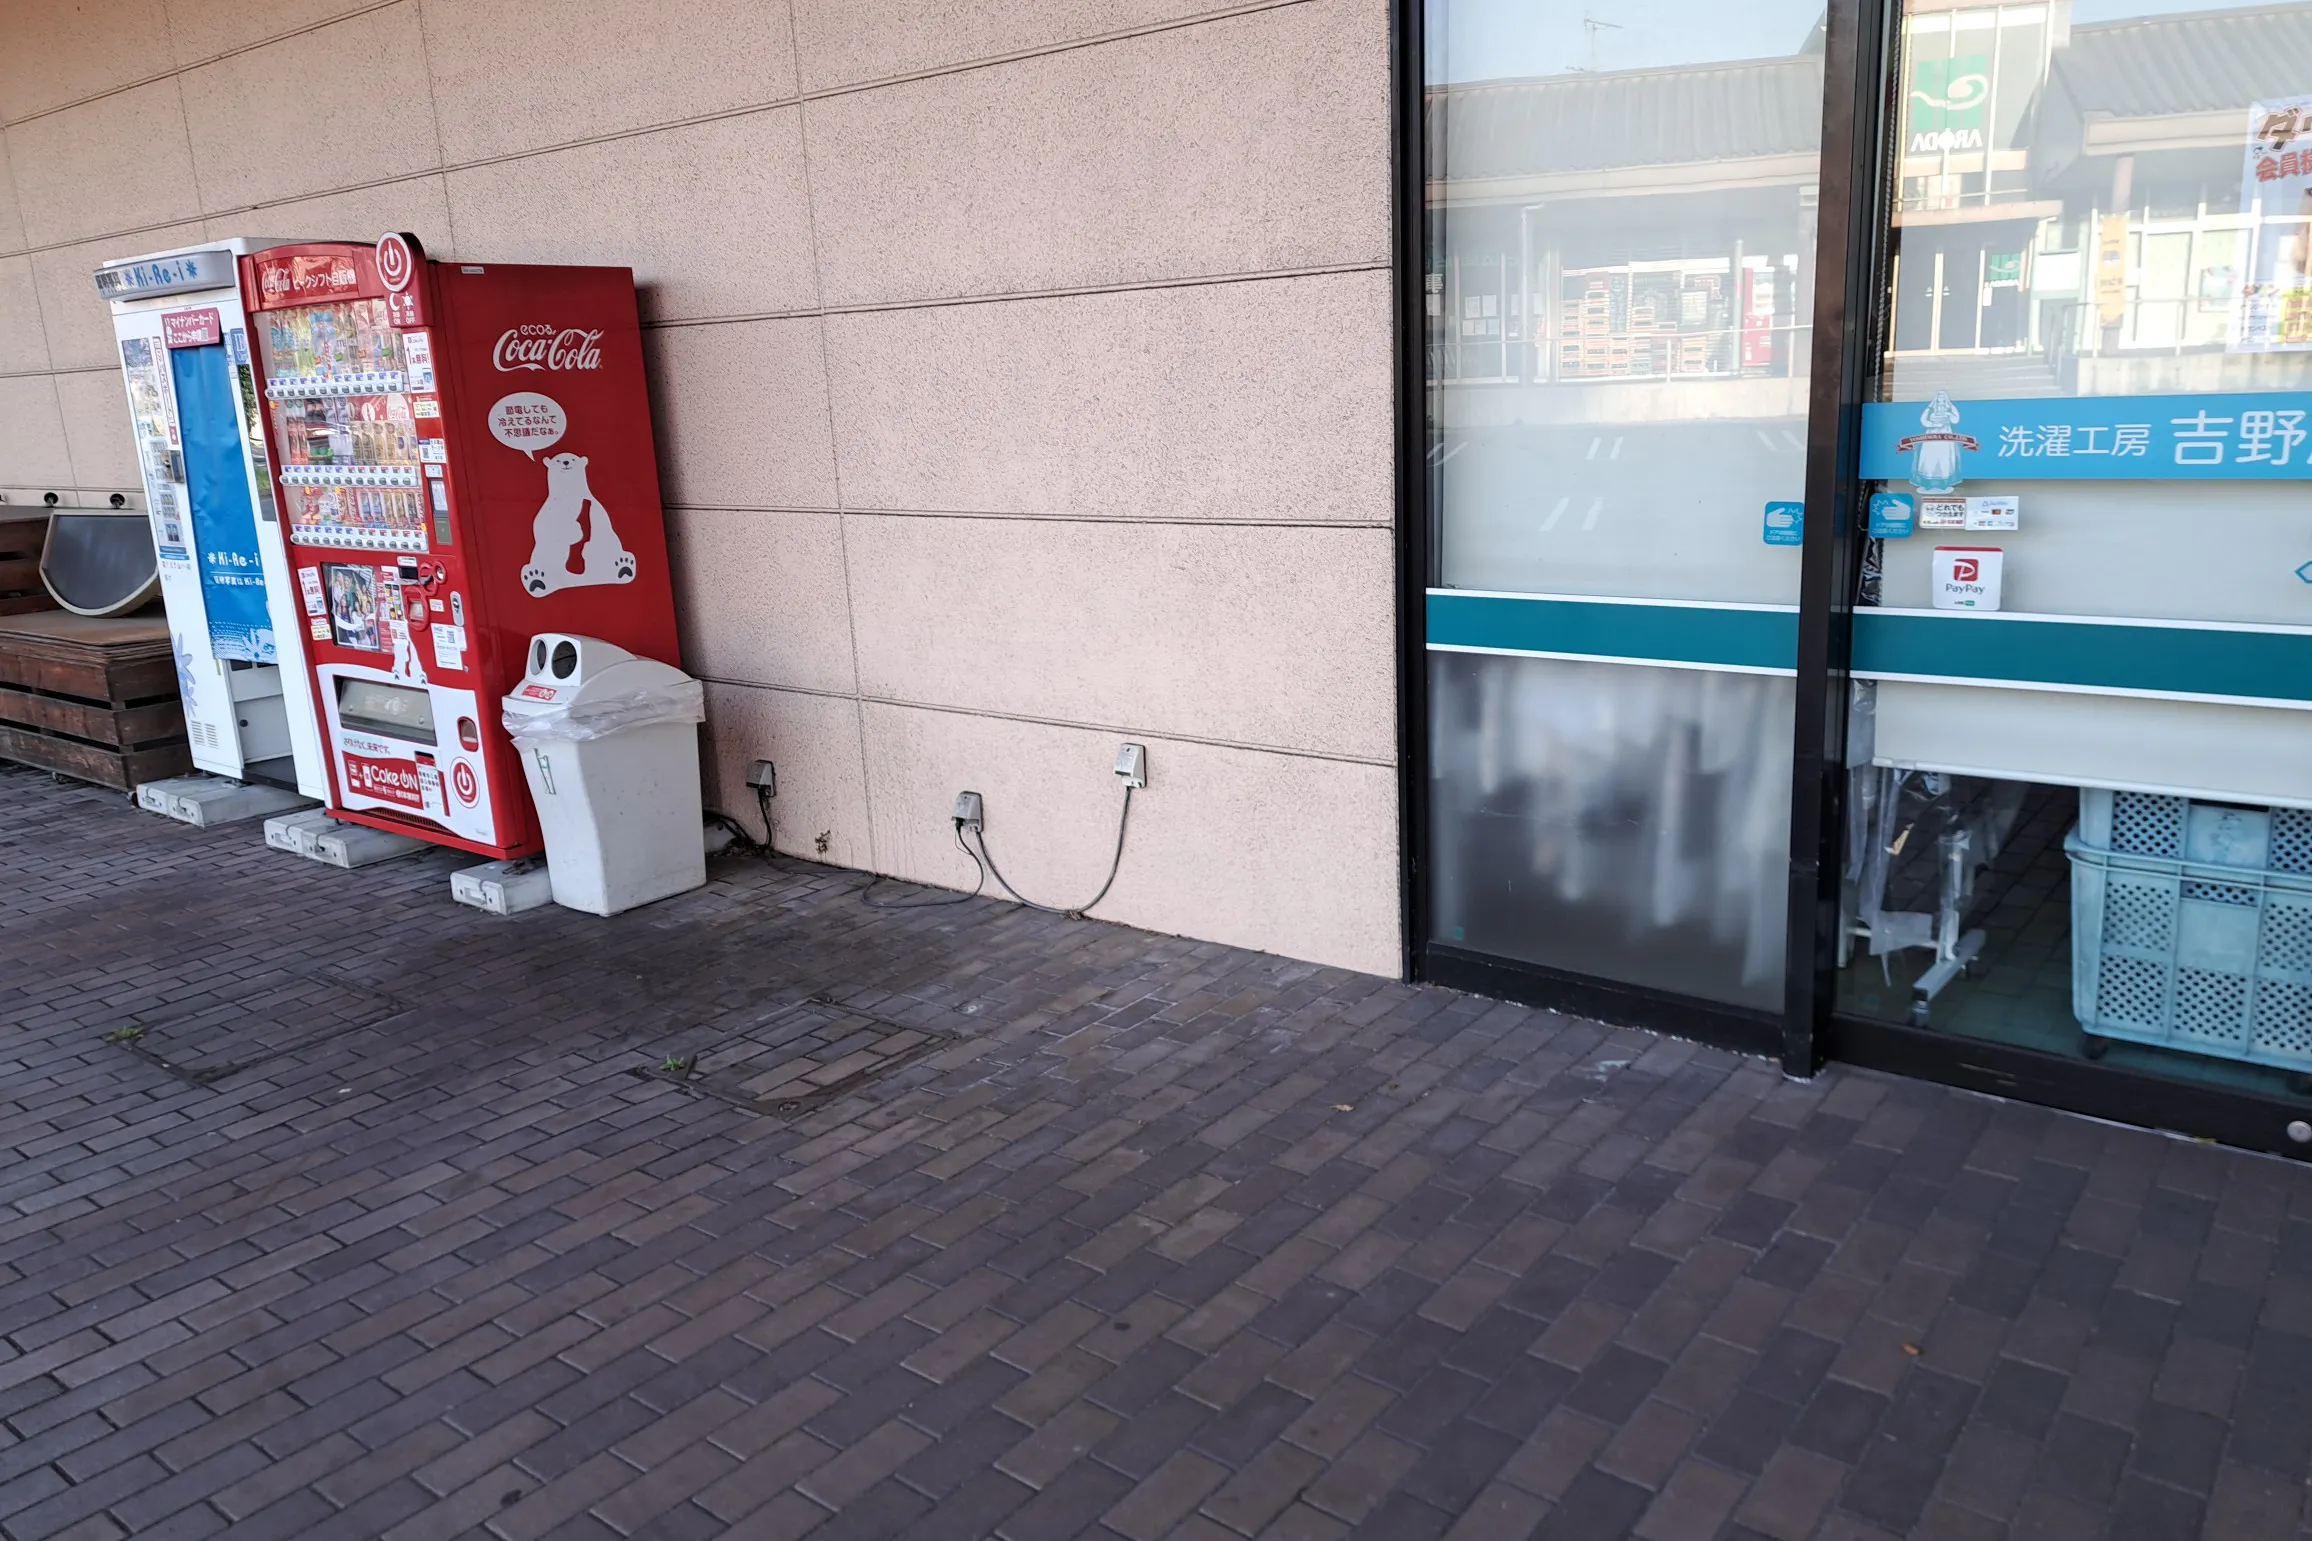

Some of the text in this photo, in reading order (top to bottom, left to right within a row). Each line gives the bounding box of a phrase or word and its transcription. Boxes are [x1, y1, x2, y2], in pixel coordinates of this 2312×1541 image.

[133, 260, 184, 287] Ki-Re-i
[492, 328, 604, 372] Coca-Cola
[505, 404, 549, 415] 節電しても
[498, 415, 557, 428] 冷えてるなんて
[1997, 409, 2312, 466] 洗濯工房 吉野
[217, 551, 260, 567] Ki-Re-i
[1945, 583, 1986, 595] PayPay
